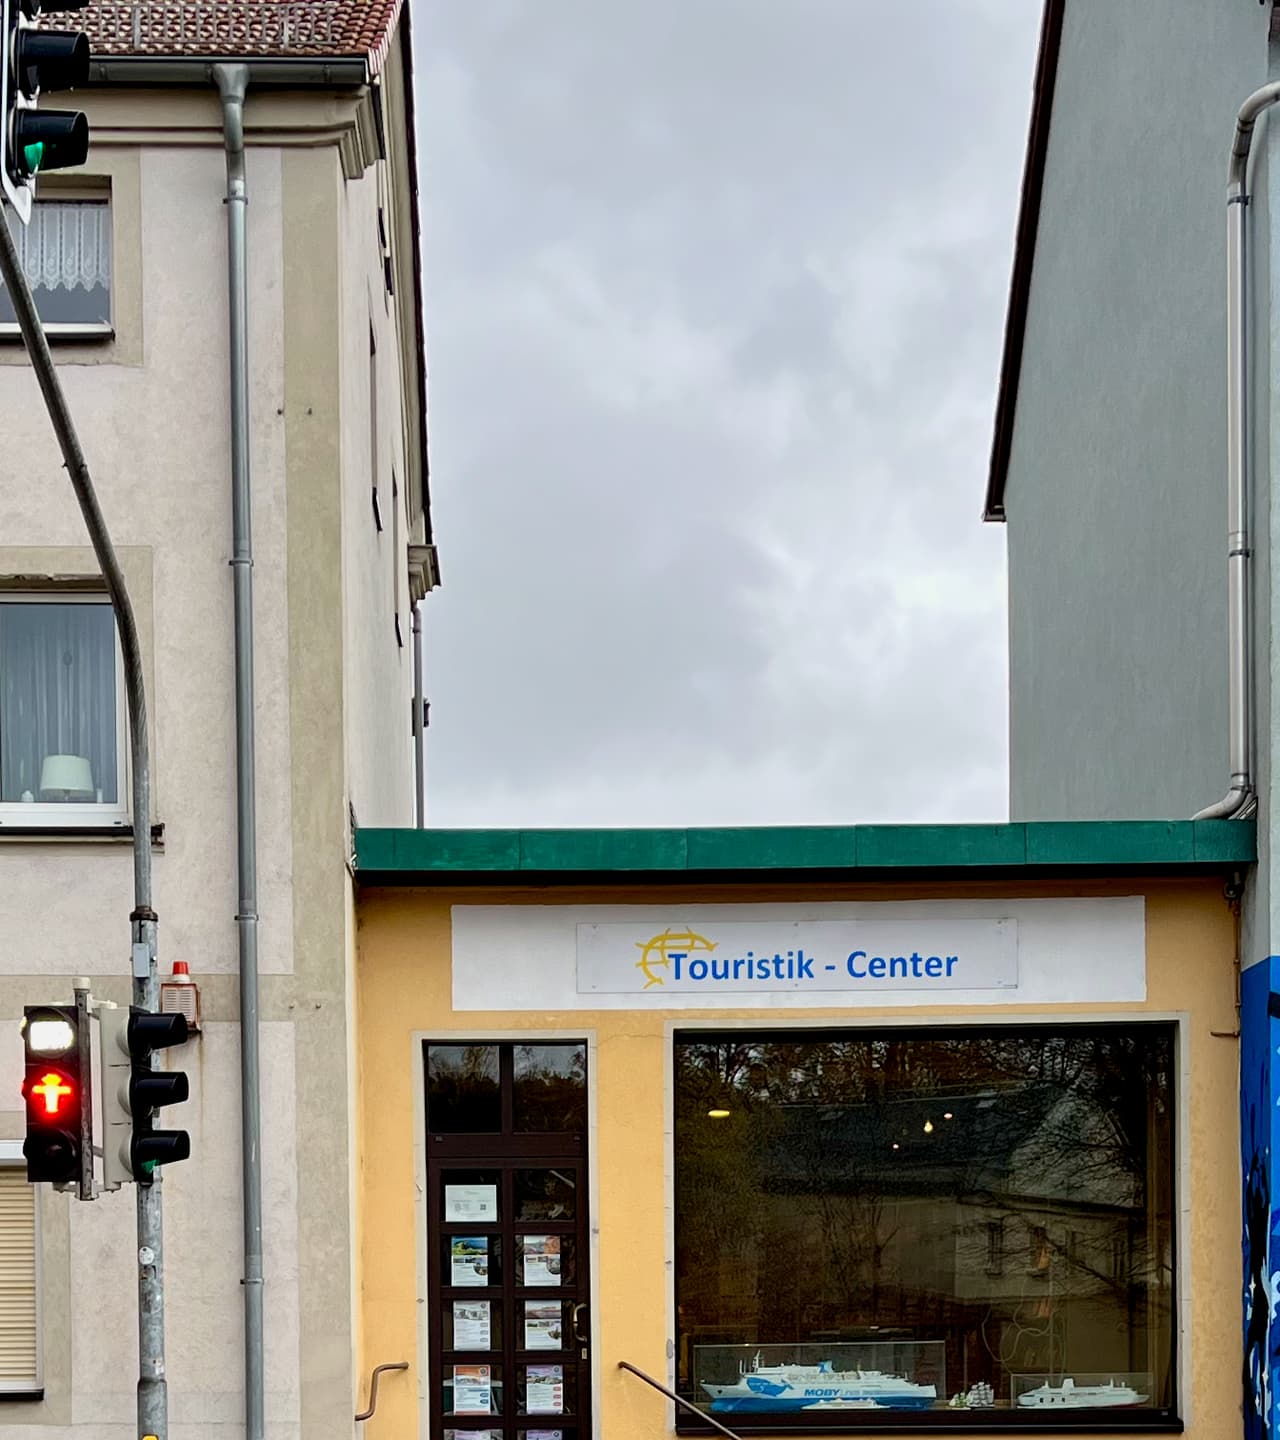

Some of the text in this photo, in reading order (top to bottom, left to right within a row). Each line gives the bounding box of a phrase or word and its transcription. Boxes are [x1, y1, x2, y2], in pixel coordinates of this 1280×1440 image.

[668, 950, 815, 981] Touristik
[847, 950, 959, 979] Center
[804, 1388, 841, 1397] MOBY
